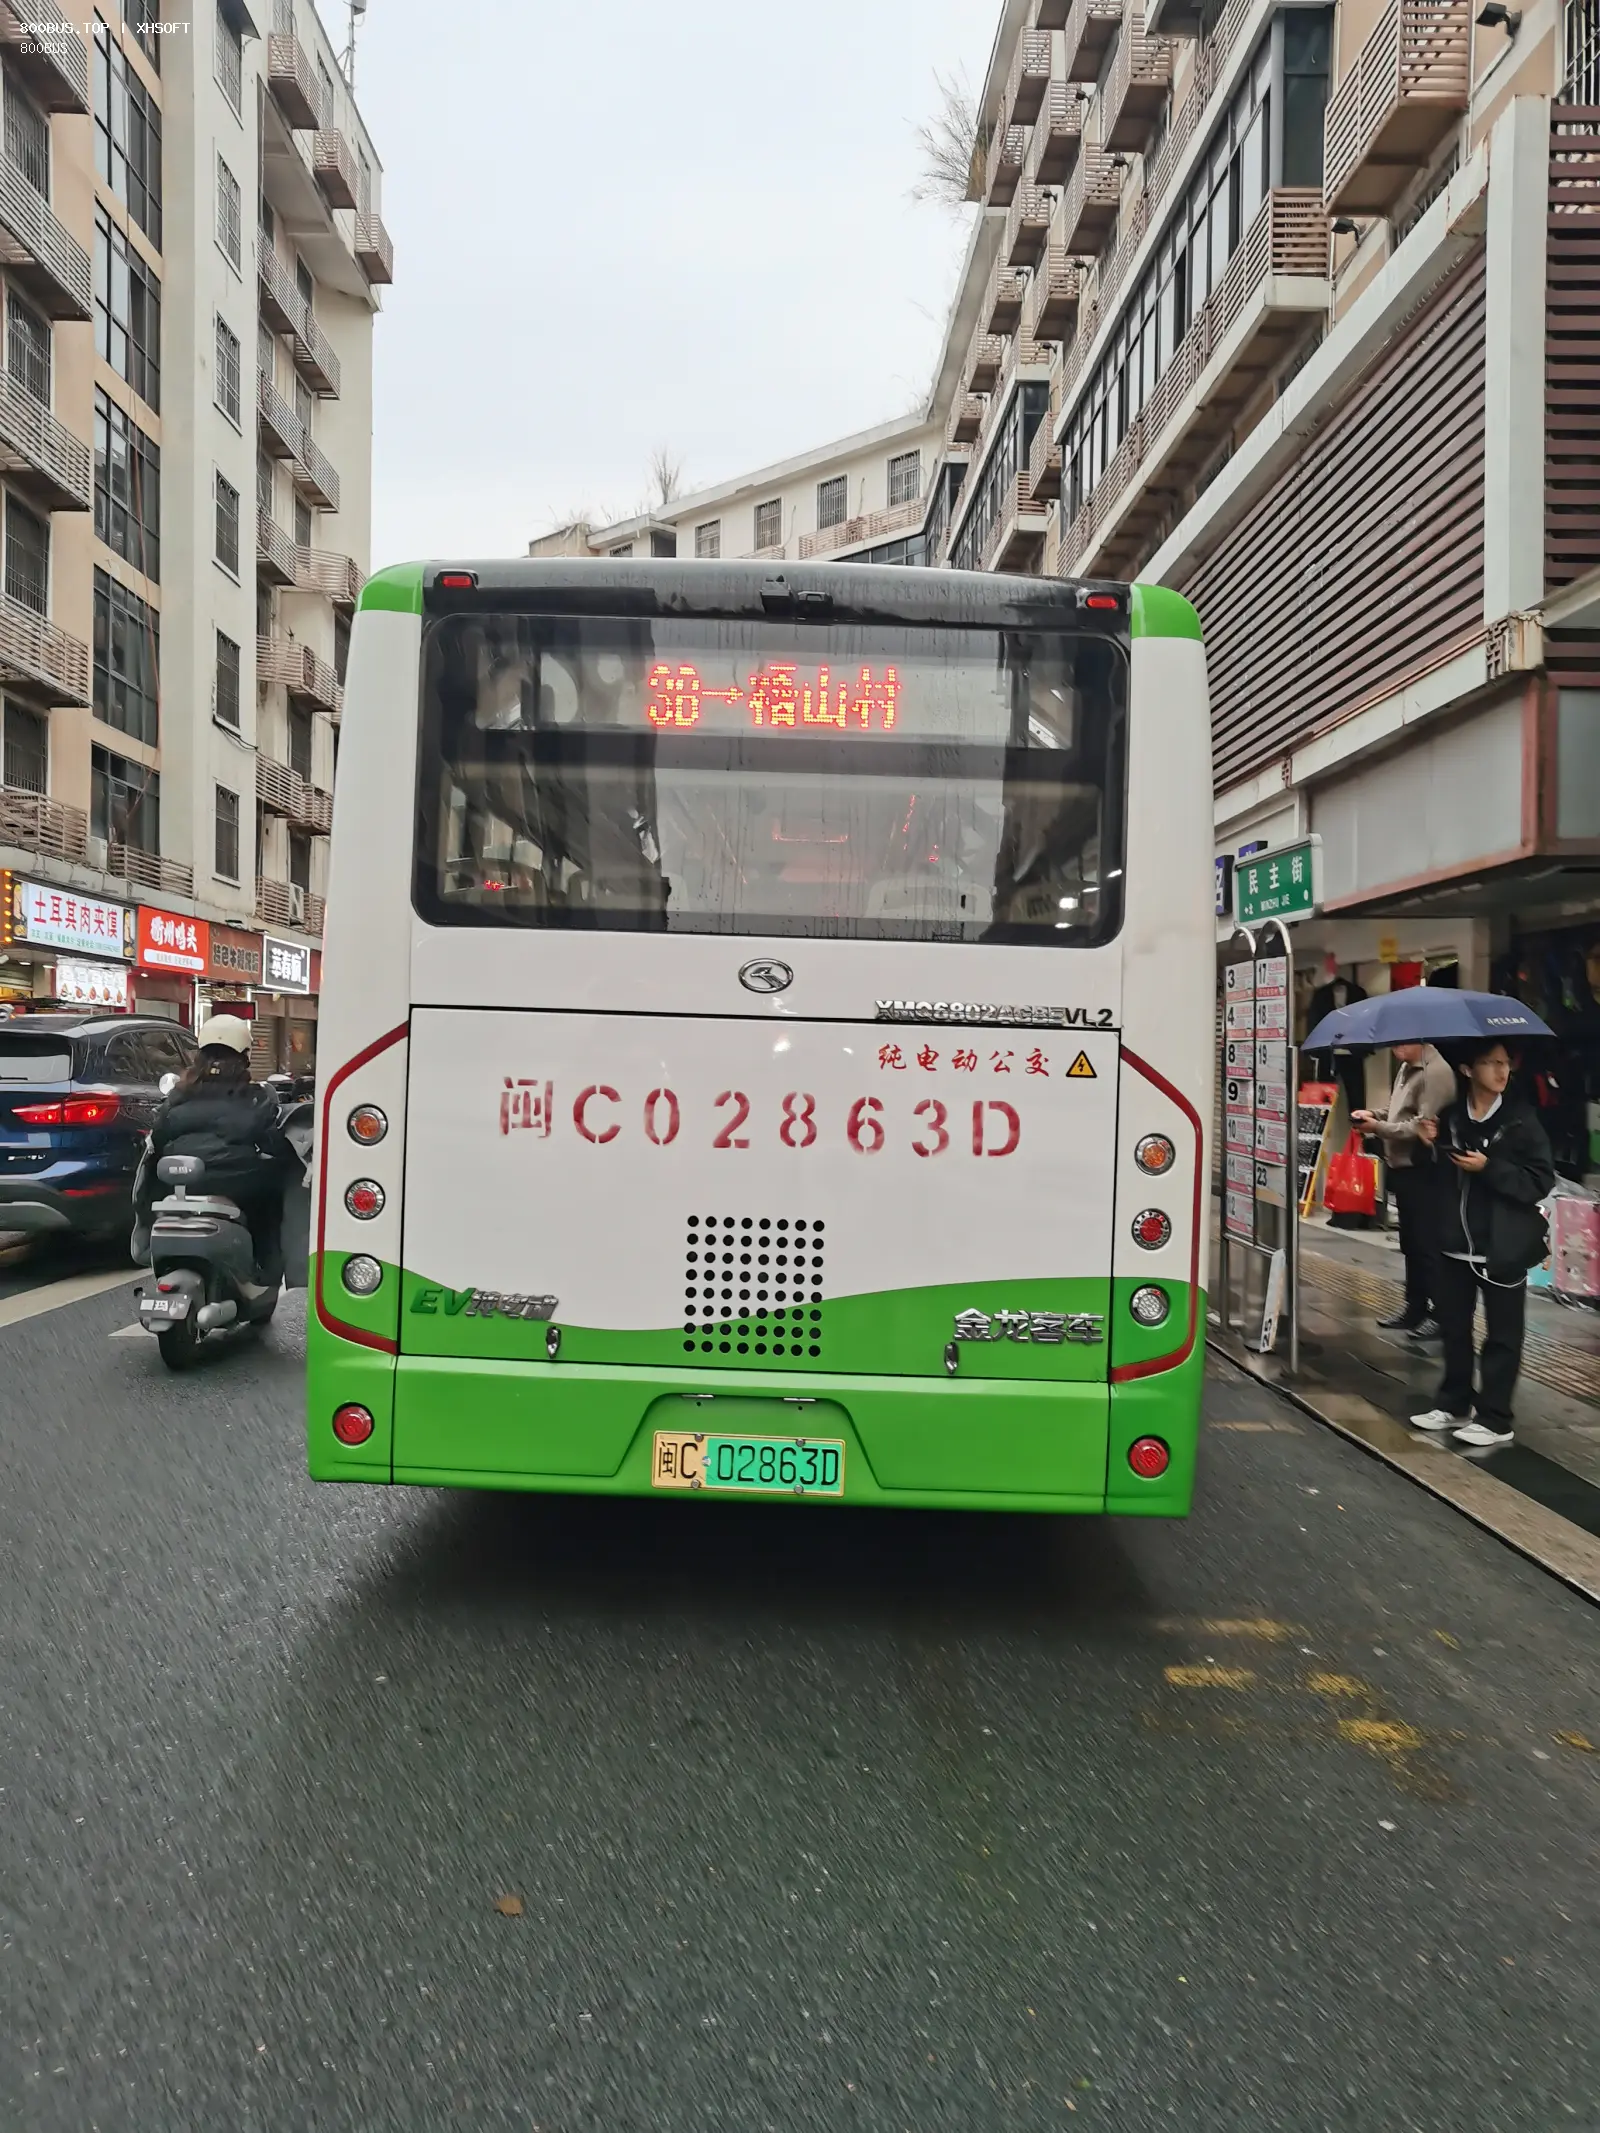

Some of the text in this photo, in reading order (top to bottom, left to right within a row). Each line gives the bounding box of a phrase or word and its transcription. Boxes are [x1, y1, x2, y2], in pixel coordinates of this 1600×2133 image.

[1247, 855, 1304, 896] 民主街
[1227, 968, 1236, 989] 3
[1227, 1006, 1236, 1027] 4
[877, 1043, 1050, 1078] 纯电动公交
[1228, 1043, 1237, 1064] 8
[1228, 1081, 1239, 1101] 9
[1257, 1084, 1267, 1106] 20
[500, 1076, 1021, 1158] 闽C02863D
[1256, 1166, 1268, 1188] 23
[953, 1307, 1105, 1345] 金龙客车
